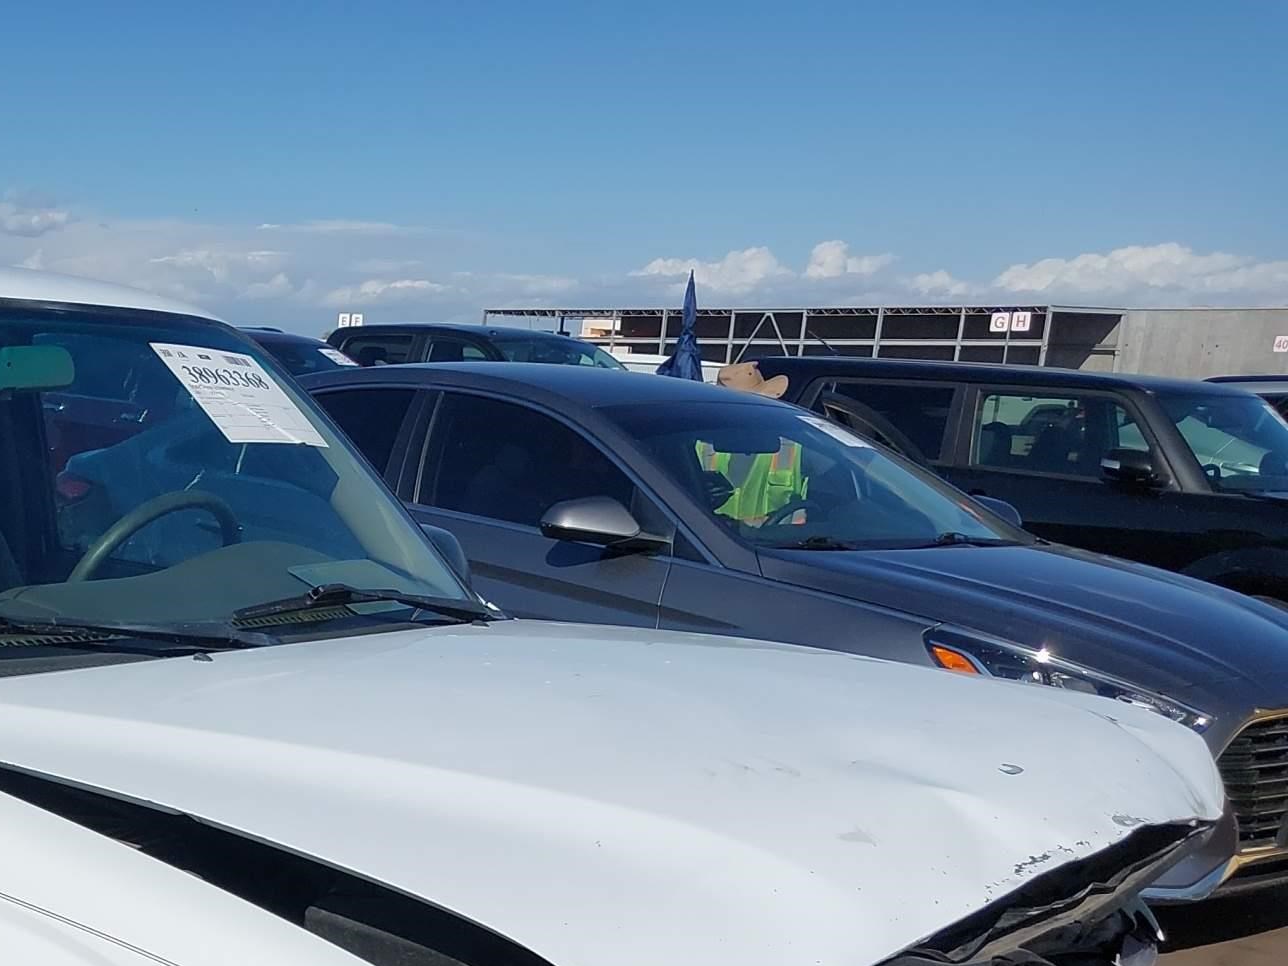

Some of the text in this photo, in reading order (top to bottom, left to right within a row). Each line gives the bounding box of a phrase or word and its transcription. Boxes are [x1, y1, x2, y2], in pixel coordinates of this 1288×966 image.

[994, 316, 1005, 328] G
[1015, 315, 1026, 328] H
[181, 365, 270, 390] 38963368
